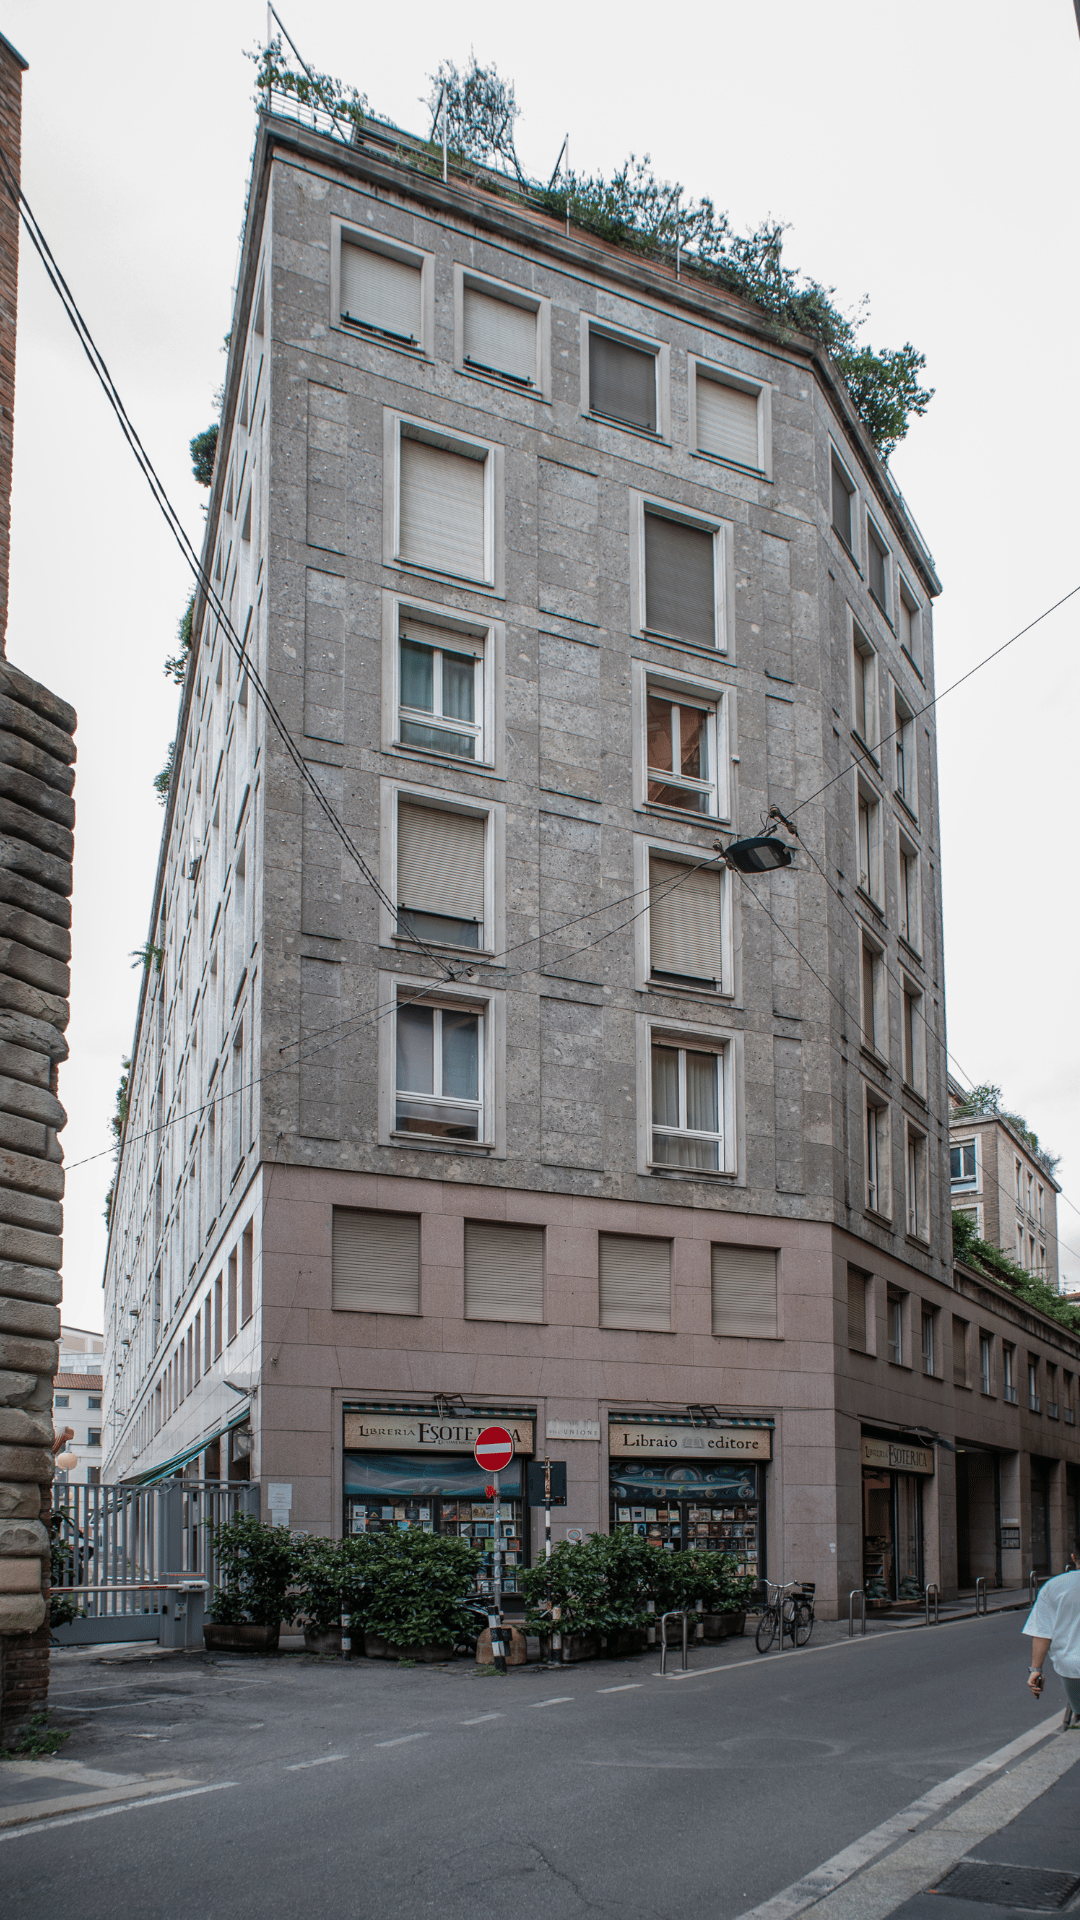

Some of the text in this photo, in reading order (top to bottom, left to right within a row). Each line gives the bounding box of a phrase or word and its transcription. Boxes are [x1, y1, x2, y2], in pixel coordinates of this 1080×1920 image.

[417, 1422, 522, 1443] ESOTEA
[622, 1433, 760, 1450] Libraio editore
[888, 1444, 927, 1467] ESOTERICA
